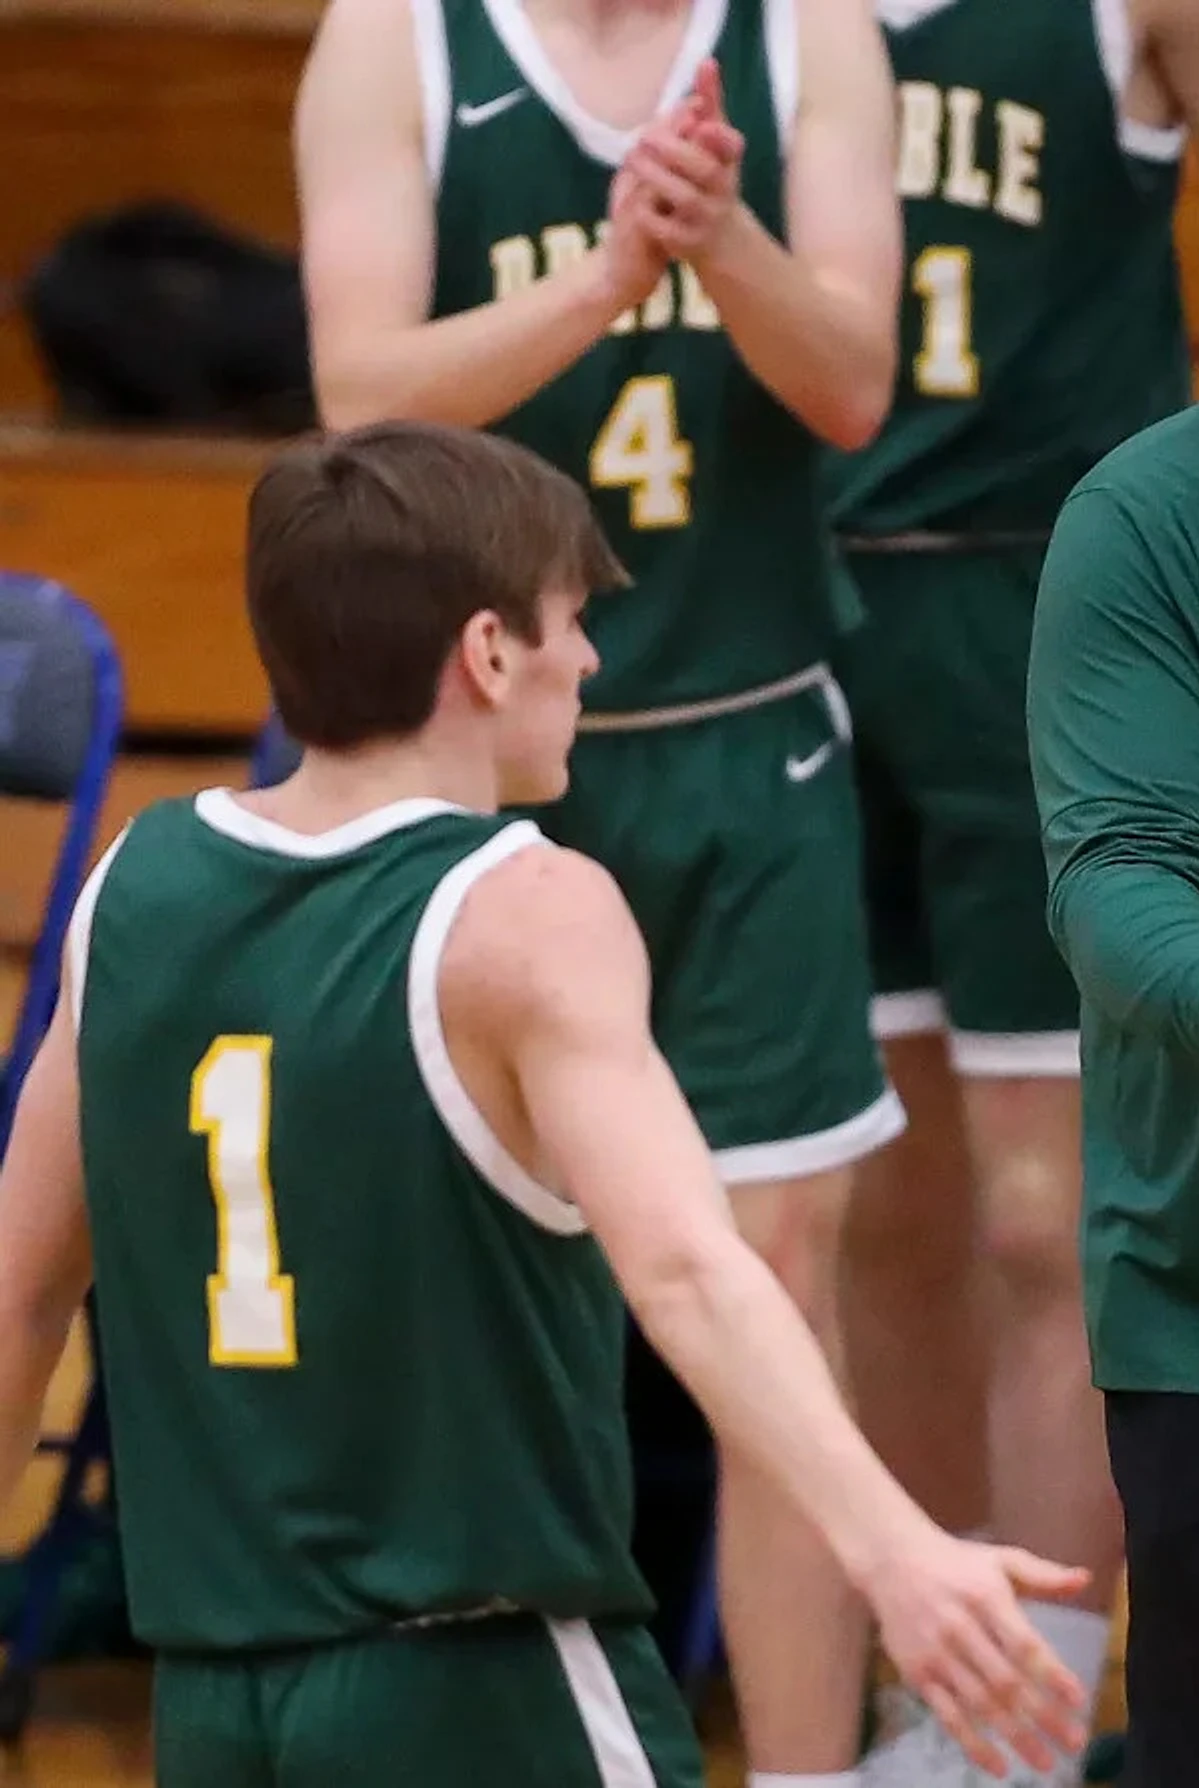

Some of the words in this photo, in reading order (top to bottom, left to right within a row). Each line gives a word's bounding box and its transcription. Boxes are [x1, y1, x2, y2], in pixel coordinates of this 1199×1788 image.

[911, 244, 982, 396] 1
[588, 373, 693, 528] 4
[188, 1034, 298, 1367] 1
